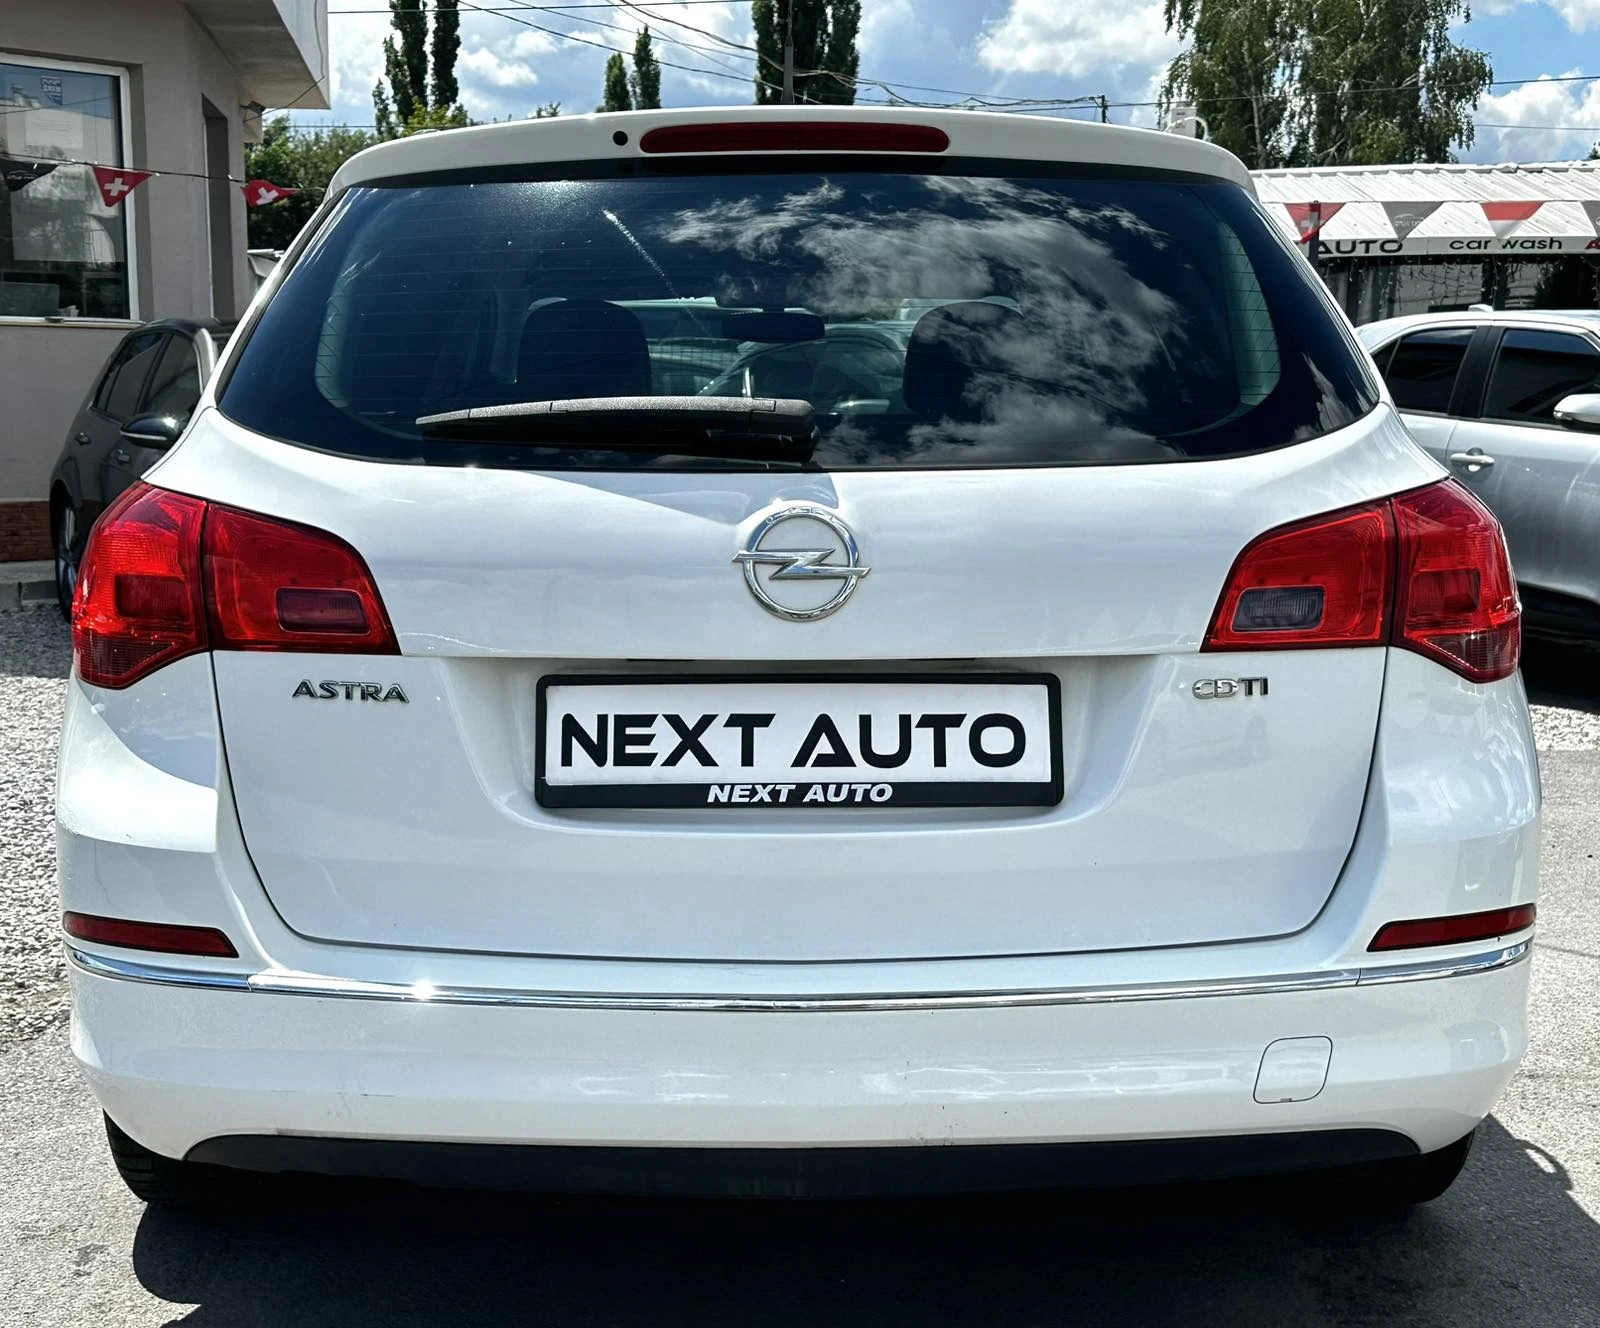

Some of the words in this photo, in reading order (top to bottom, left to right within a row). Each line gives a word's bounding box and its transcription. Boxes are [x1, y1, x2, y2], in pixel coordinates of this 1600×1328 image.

[1449, 239, 1492, 250] car
[1501, 237, 1562, 250] wash
[292, 679, 410, 703] ASTRA
[1192, 677, 1268, 699] CDTI
[561, 713, 776, 768] NEXT
[790, 713, 1026, 768] AUTO
[707, 784, 796, 803] NEXT
[803, 784, 893, 803] AUTO
